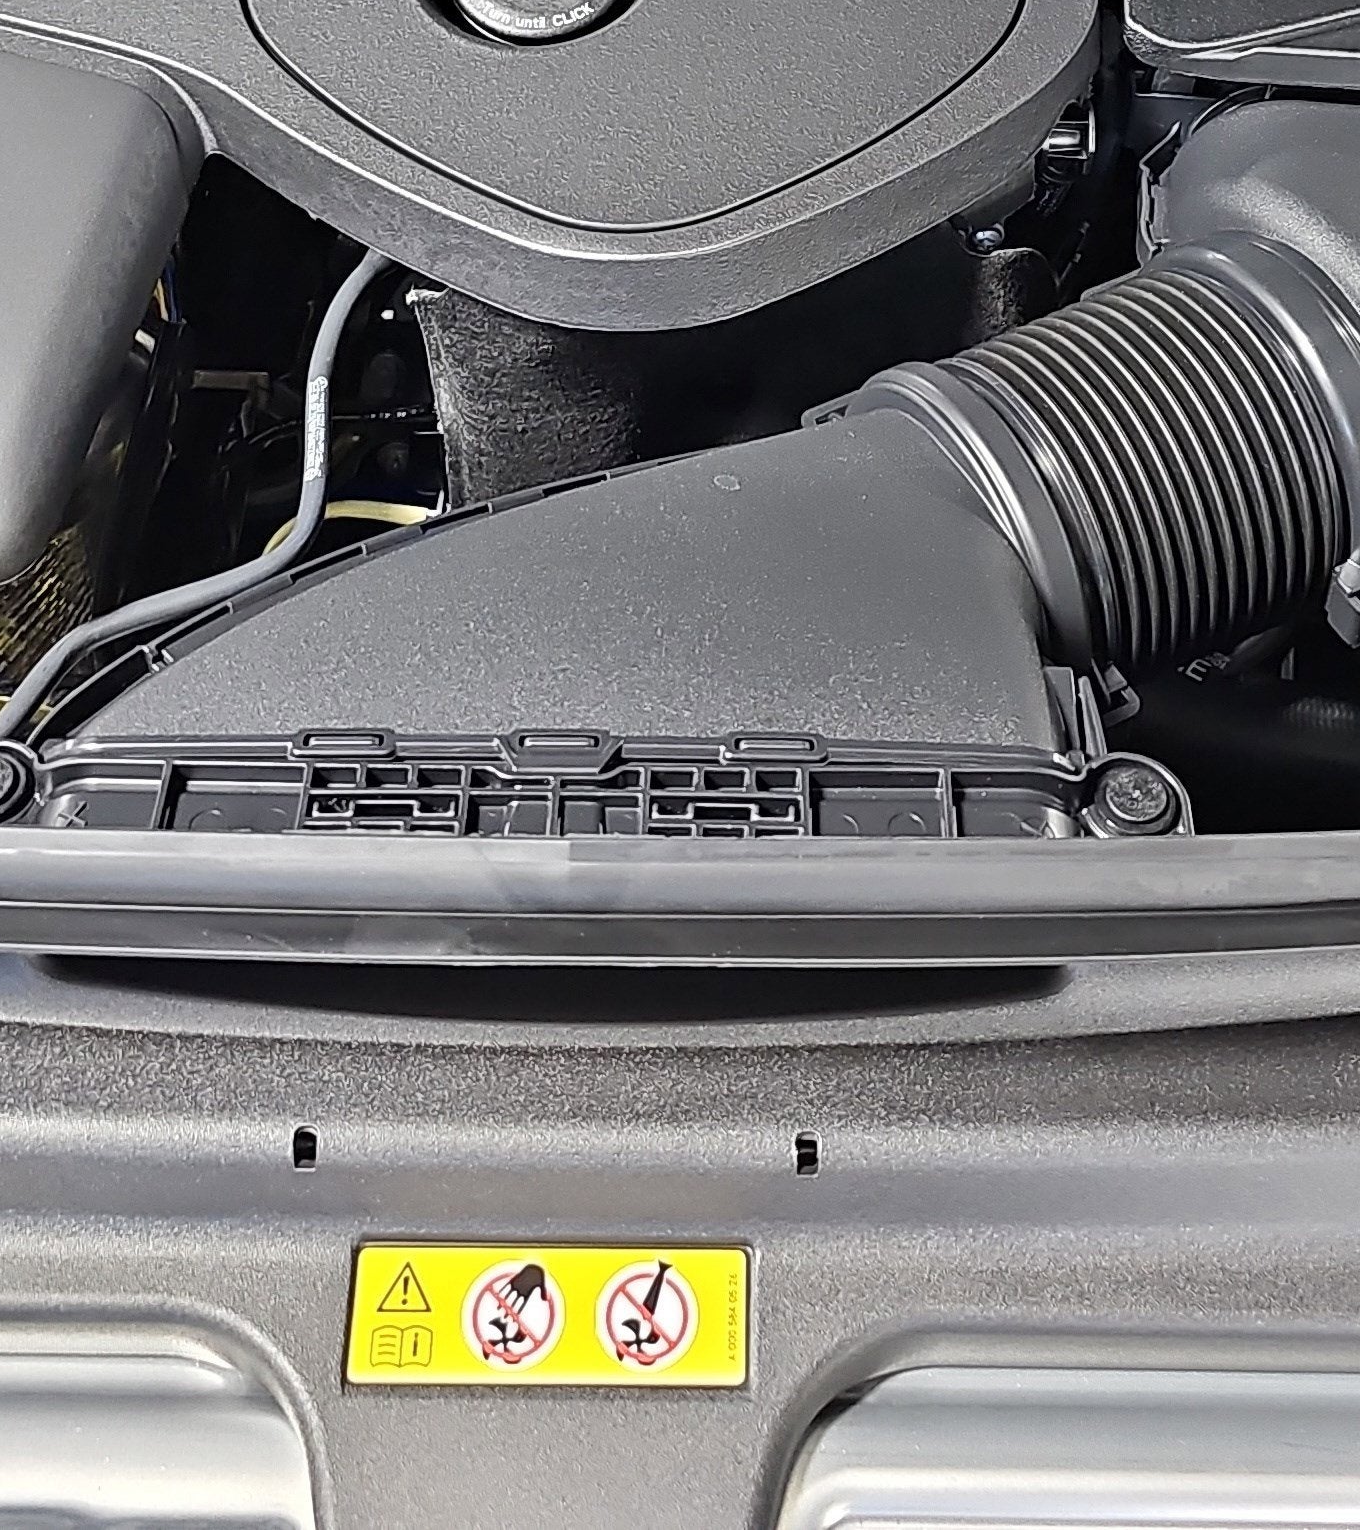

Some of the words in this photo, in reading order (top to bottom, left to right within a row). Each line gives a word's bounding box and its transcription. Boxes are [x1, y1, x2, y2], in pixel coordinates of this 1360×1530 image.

[482, 1, 511, 25] Turn
[515, 15, 546, 29] until
[552, 1, 595, 28] CLICK
